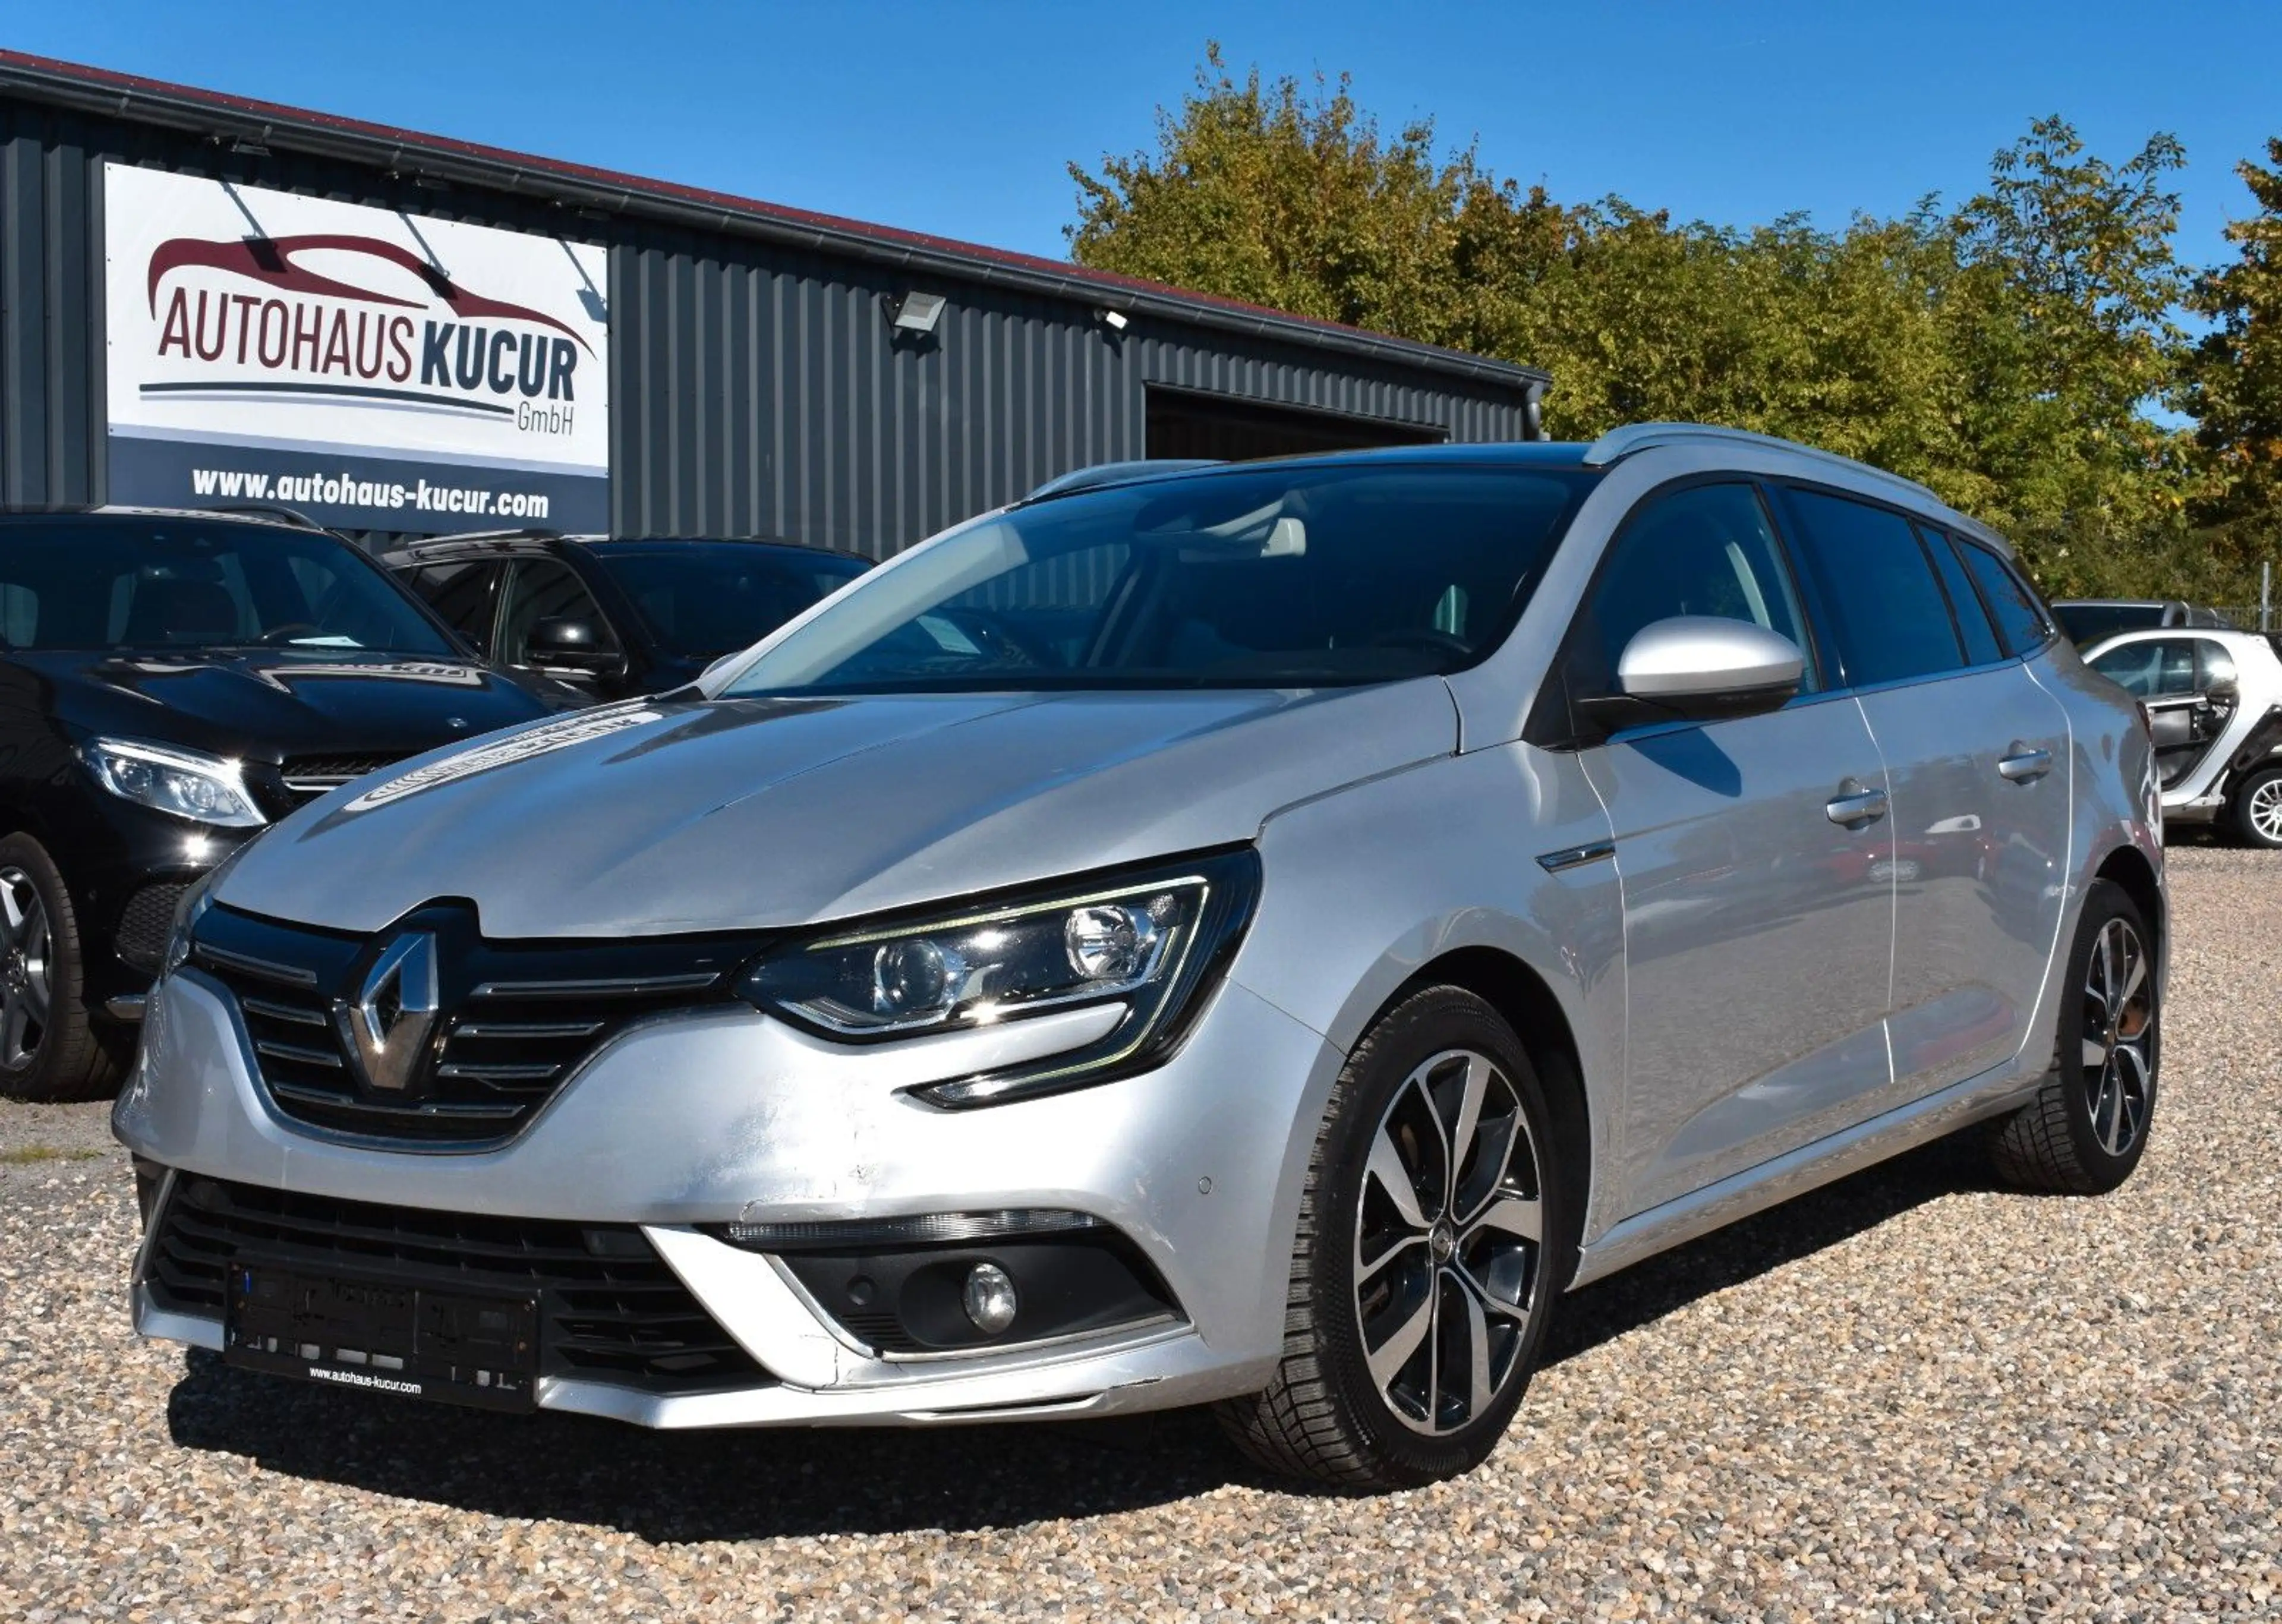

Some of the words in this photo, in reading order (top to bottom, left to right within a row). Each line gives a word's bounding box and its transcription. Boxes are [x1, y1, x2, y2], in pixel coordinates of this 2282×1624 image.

[159, 287, 414, 383] AUTOHAUS
[421, 320, 577, 402] KUCUR
[518, 401, 573, 436] GmbH
[193, 469, 549, 518] www.autohaus-kucur.com
[309, 1367, 422, 1394] www.autohaus-kucur.com
